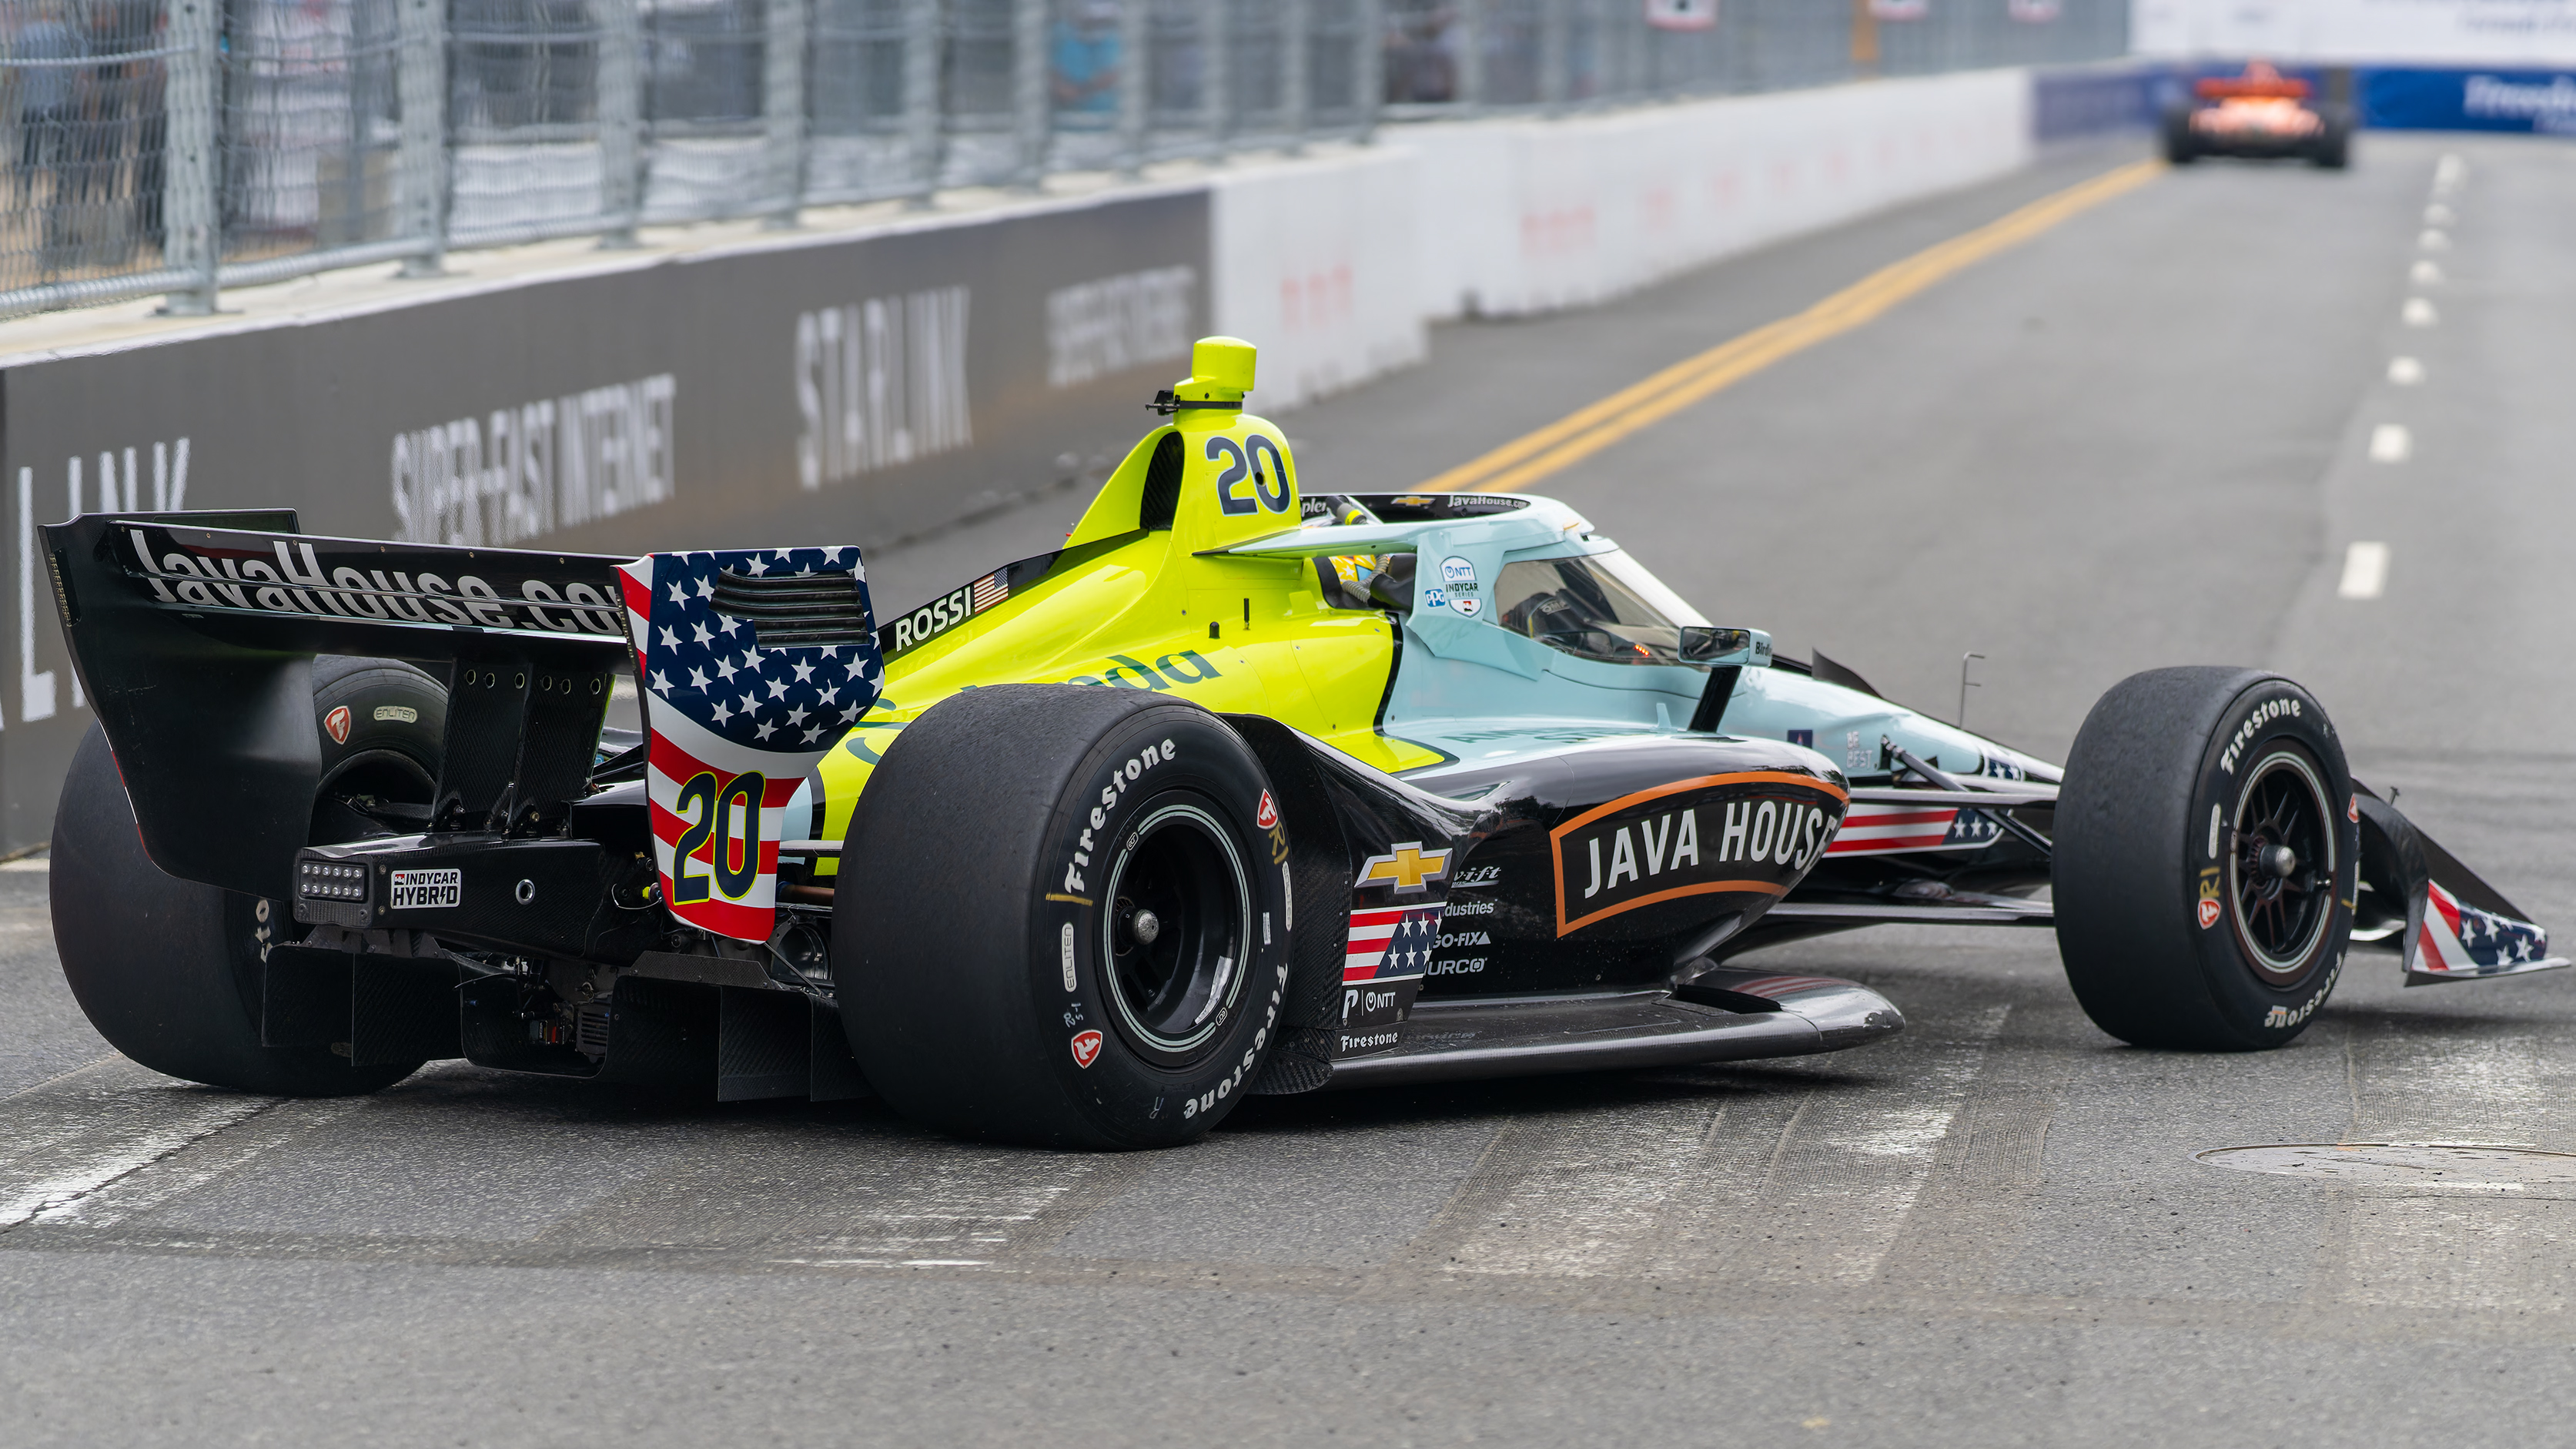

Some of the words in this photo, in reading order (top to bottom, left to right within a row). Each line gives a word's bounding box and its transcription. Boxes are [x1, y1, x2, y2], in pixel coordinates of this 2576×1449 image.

[1205, 433, 1291, 516] 20
[129, 529, 624, 637] JavaHouse.co
[1446, 583, 1479, 592] INDYCAR
[1455, 567, 1470, 577] NTT
[895, 585, 972, 652] ROSSI
[376, 708, 416, 719] ENLITEN
[2220, 697, 2301, 775] Firestone
[673, 770, 766, 906] 20
[1065, 738, 1176, 893] Firestone
[406, 872, 458, 885] INDYCAR
[1584, 808, 1699, 899] JAVA
[1443, 900, 1494, 917] dustries
[1064, 926, 1076, 989] ENLITEN
[1424, 959, 1485, 975] URCO
[2264, 951, 2342, 1029] Firestone
[1377, 992, 1396, 1009] NTT
[1183, 962, 1289, 1119] Firestone
[1340, 1032, 1398, 1052] Firestone
